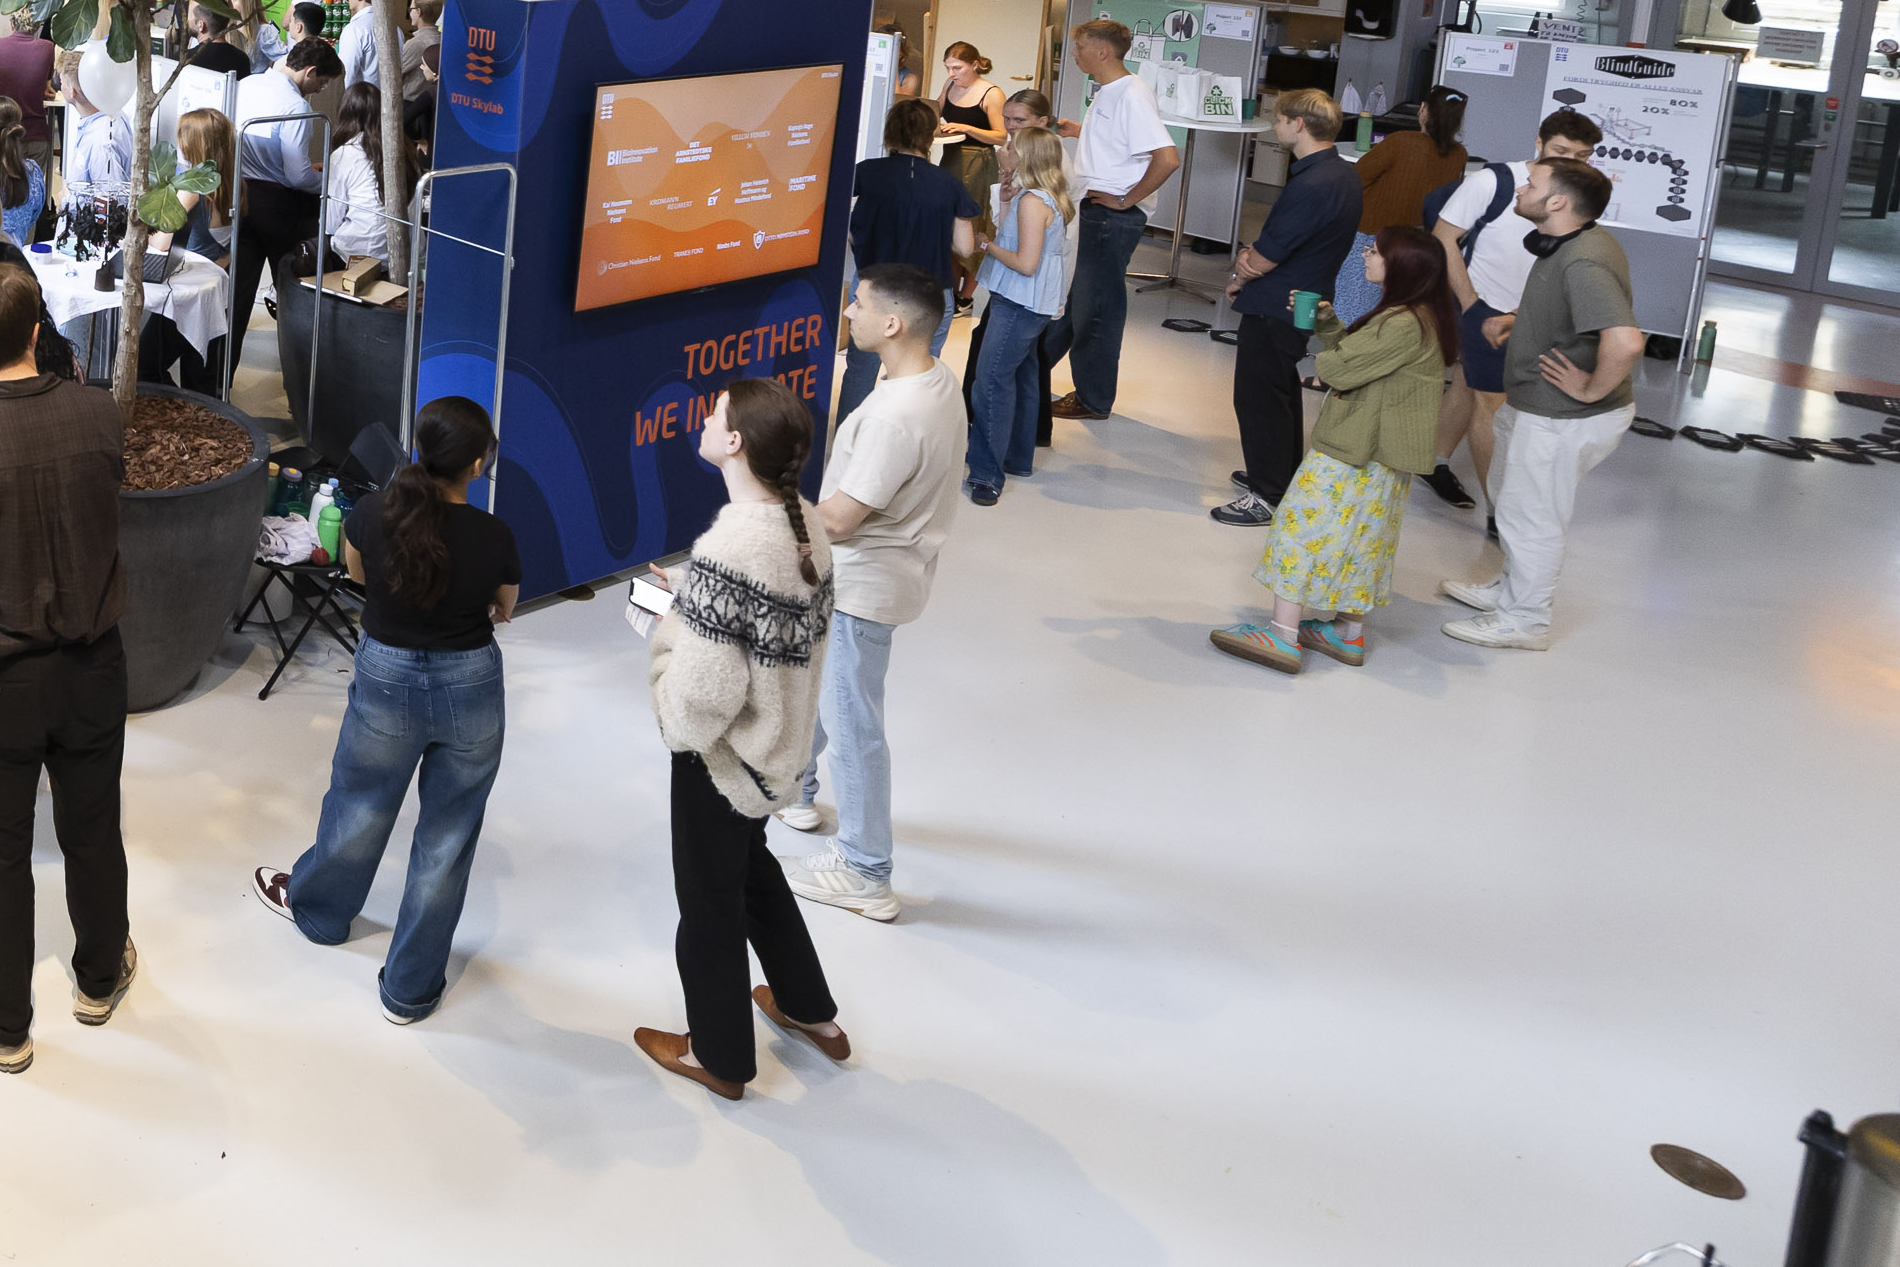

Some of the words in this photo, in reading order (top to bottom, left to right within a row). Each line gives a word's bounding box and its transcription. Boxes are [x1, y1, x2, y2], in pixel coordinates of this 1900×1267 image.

[468, 26, 496, 51] DTU
[1596, 56, 1674, 77] BlindGuide
[452, 93, 470, 106] DTU
[472, 98, 504, 115] Skylab
[1204, 104, 1234, 116] BIN
[1642, 106, 1670, 115] 20%
[1669, 99, 1699, 108] 80%
[707, 196, 718, 207] EY
[684, 314, 822, 379] TOGETHER
[635, 402, 679, 446] WE
